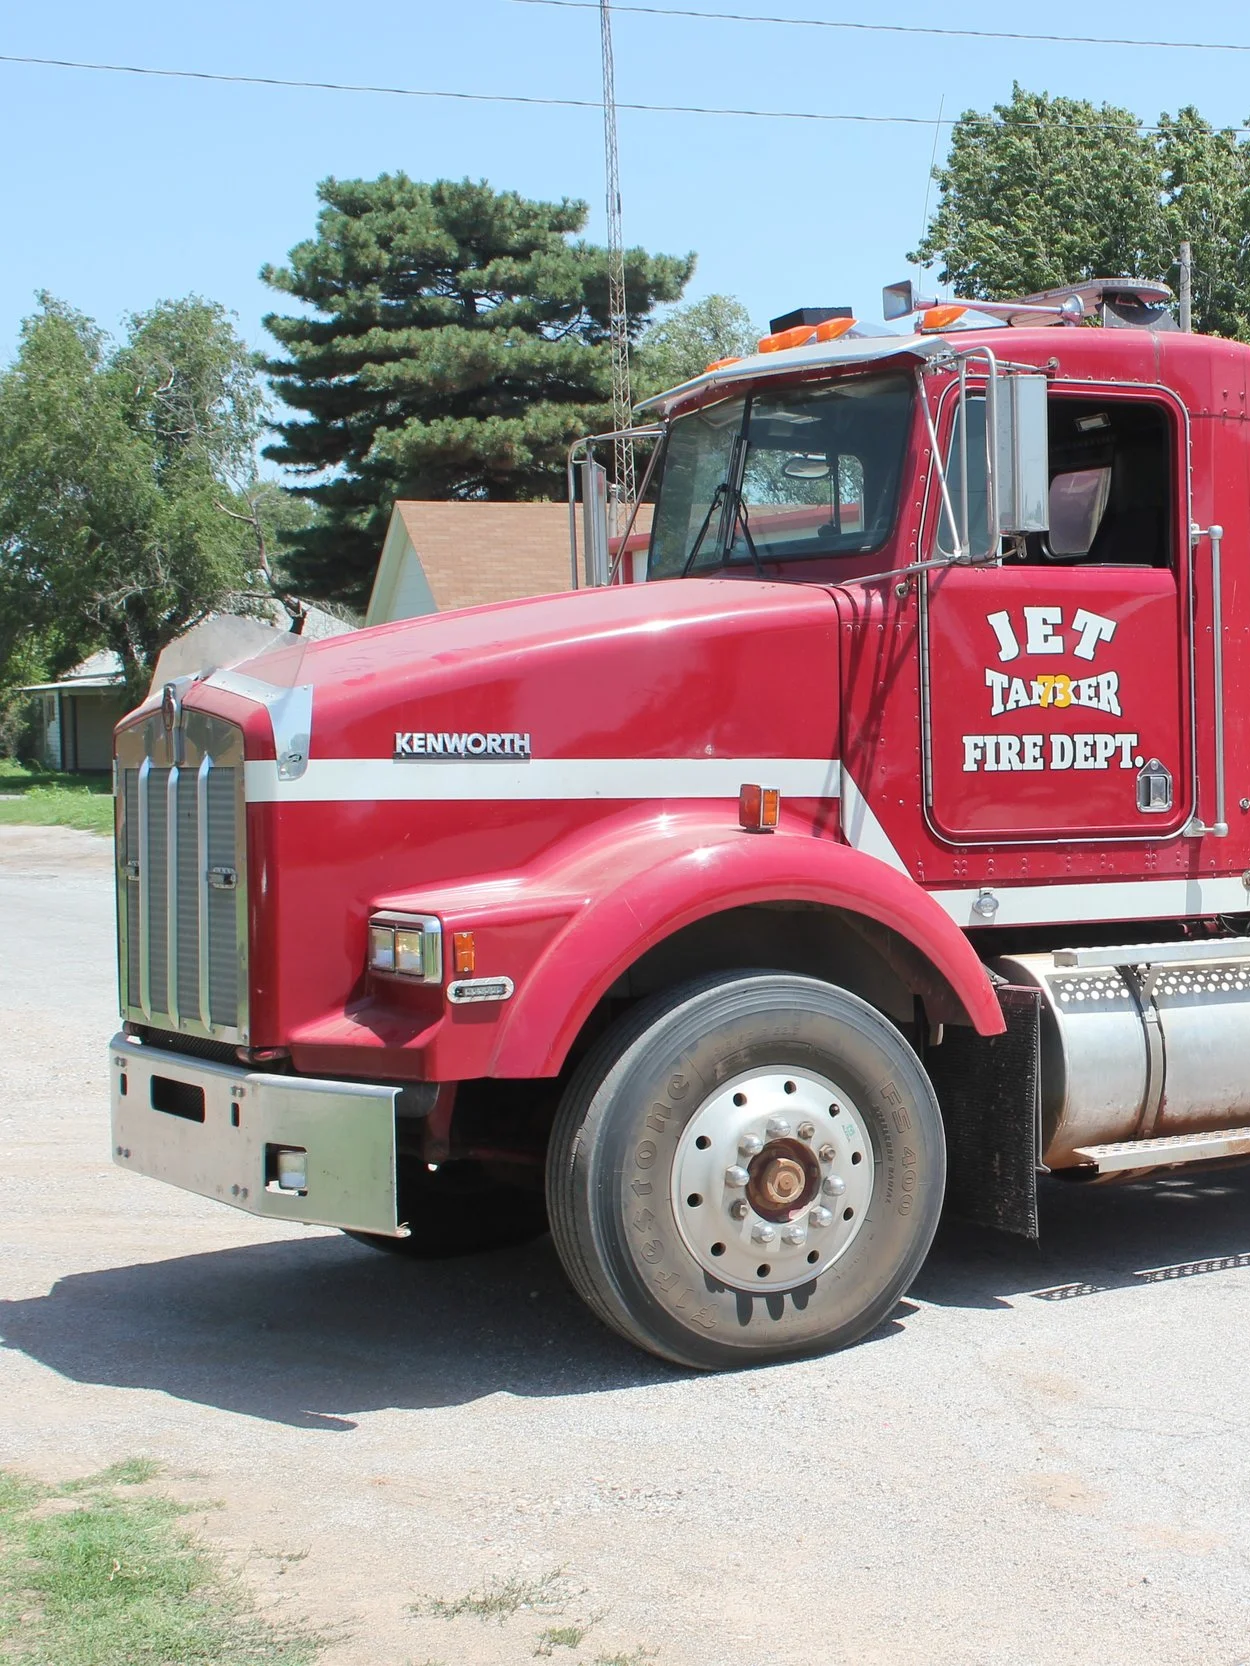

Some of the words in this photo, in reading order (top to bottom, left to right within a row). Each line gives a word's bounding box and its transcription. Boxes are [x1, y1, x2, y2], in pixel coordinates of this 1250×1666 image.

[986, 606, 1117, 662] JET
[1036, 674, 1072, 708] 73
[395, 732, 531, 754] KENWORTH
[962, 734, 1044, 772] FIRE
[1049, 733, 1144, 770] DEPT.
[880, 1081, 912, 1133] FS
[898, 1146, 916, 1216] 400
[630, 1073, 718, 1328] Firestone
